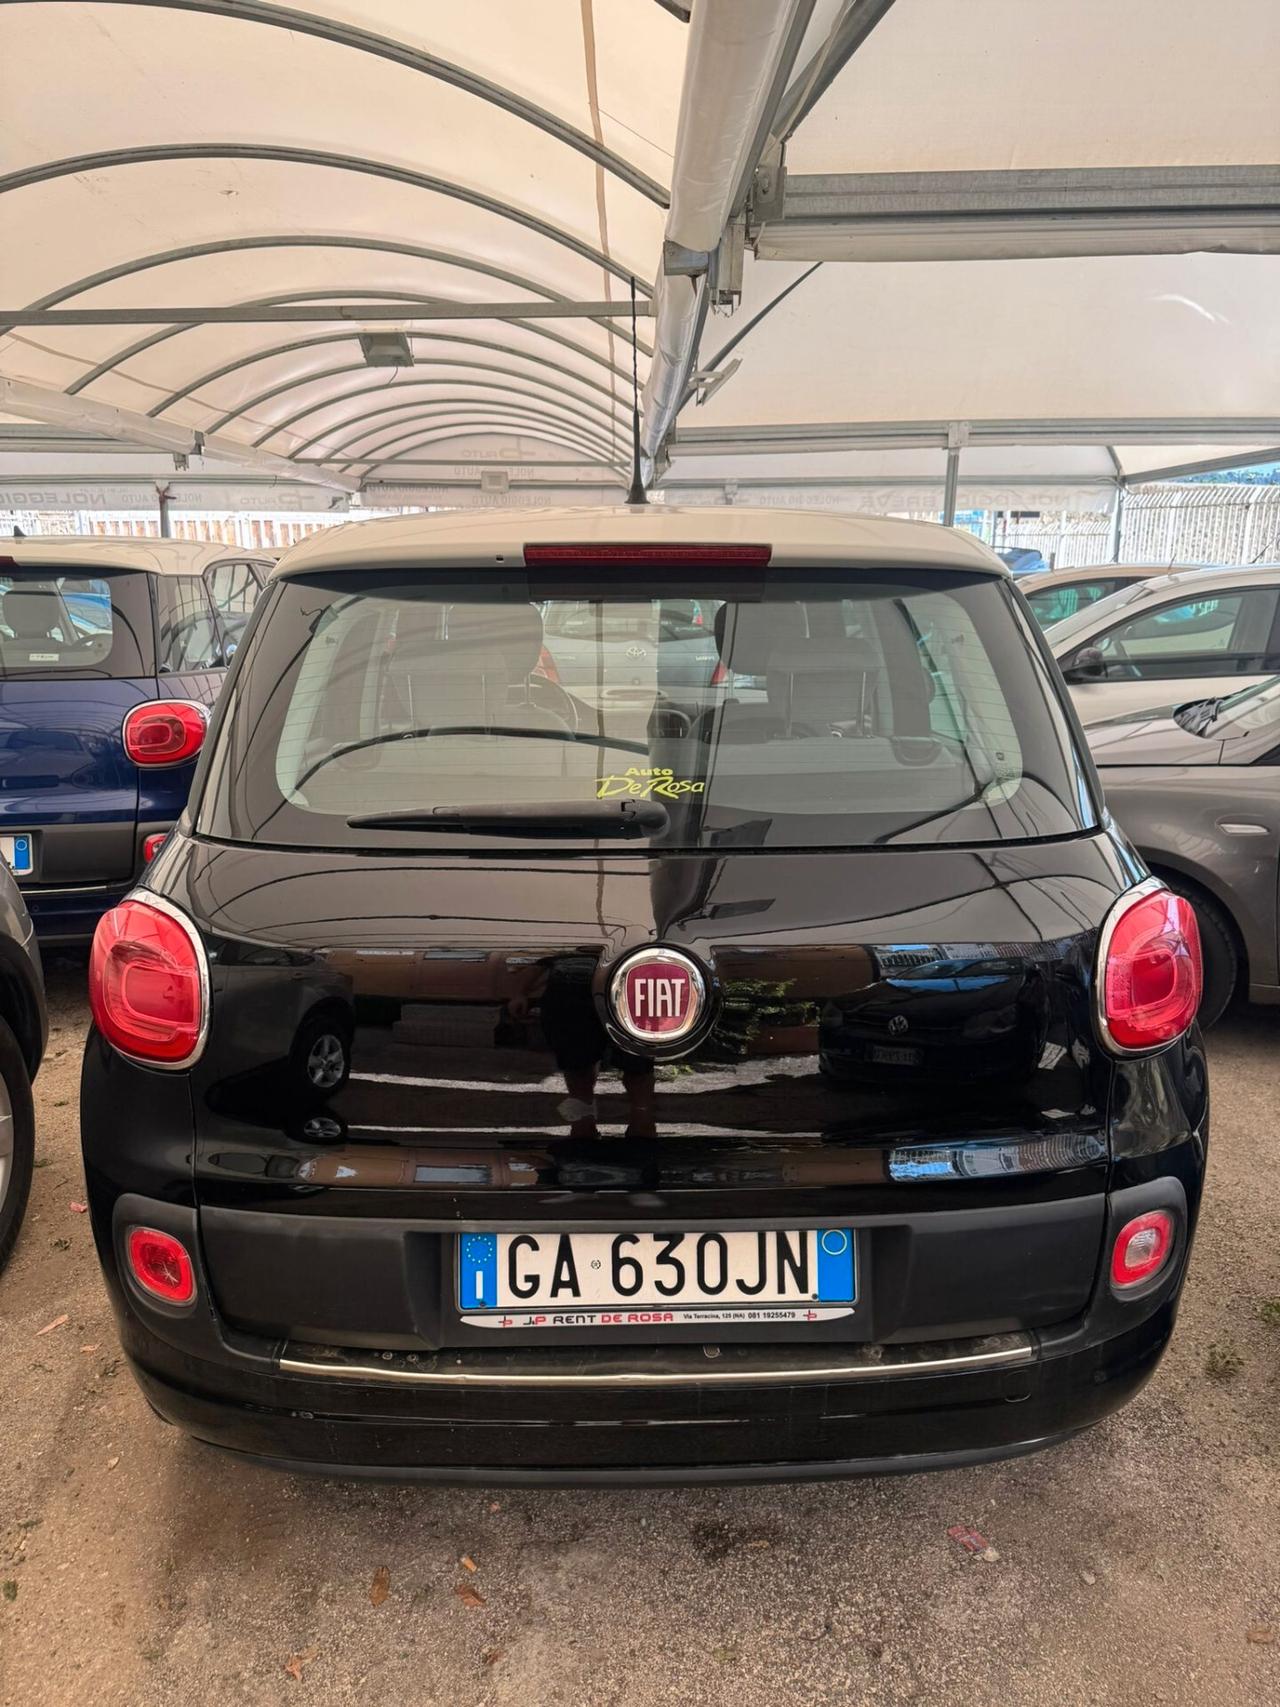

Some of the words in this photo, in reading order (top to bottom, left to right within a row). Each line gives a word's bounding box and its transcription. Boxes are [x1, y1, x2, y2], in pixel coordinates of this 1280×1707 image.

[624, 767, 674, 776] Auto
[634, 978, 686, 1017] FIAT
[475, 1270, 484, 1300] I
[508, 1233, 581, 1299] GA
[611, 1231, 809, 1297] 630JN
[553, 1314, 597, 1325] RENT
[601, 1313, 623, 1324] DE
[627, 1312, 673, 1323] ROSA
[748, 1311, 760, 1319] 081
